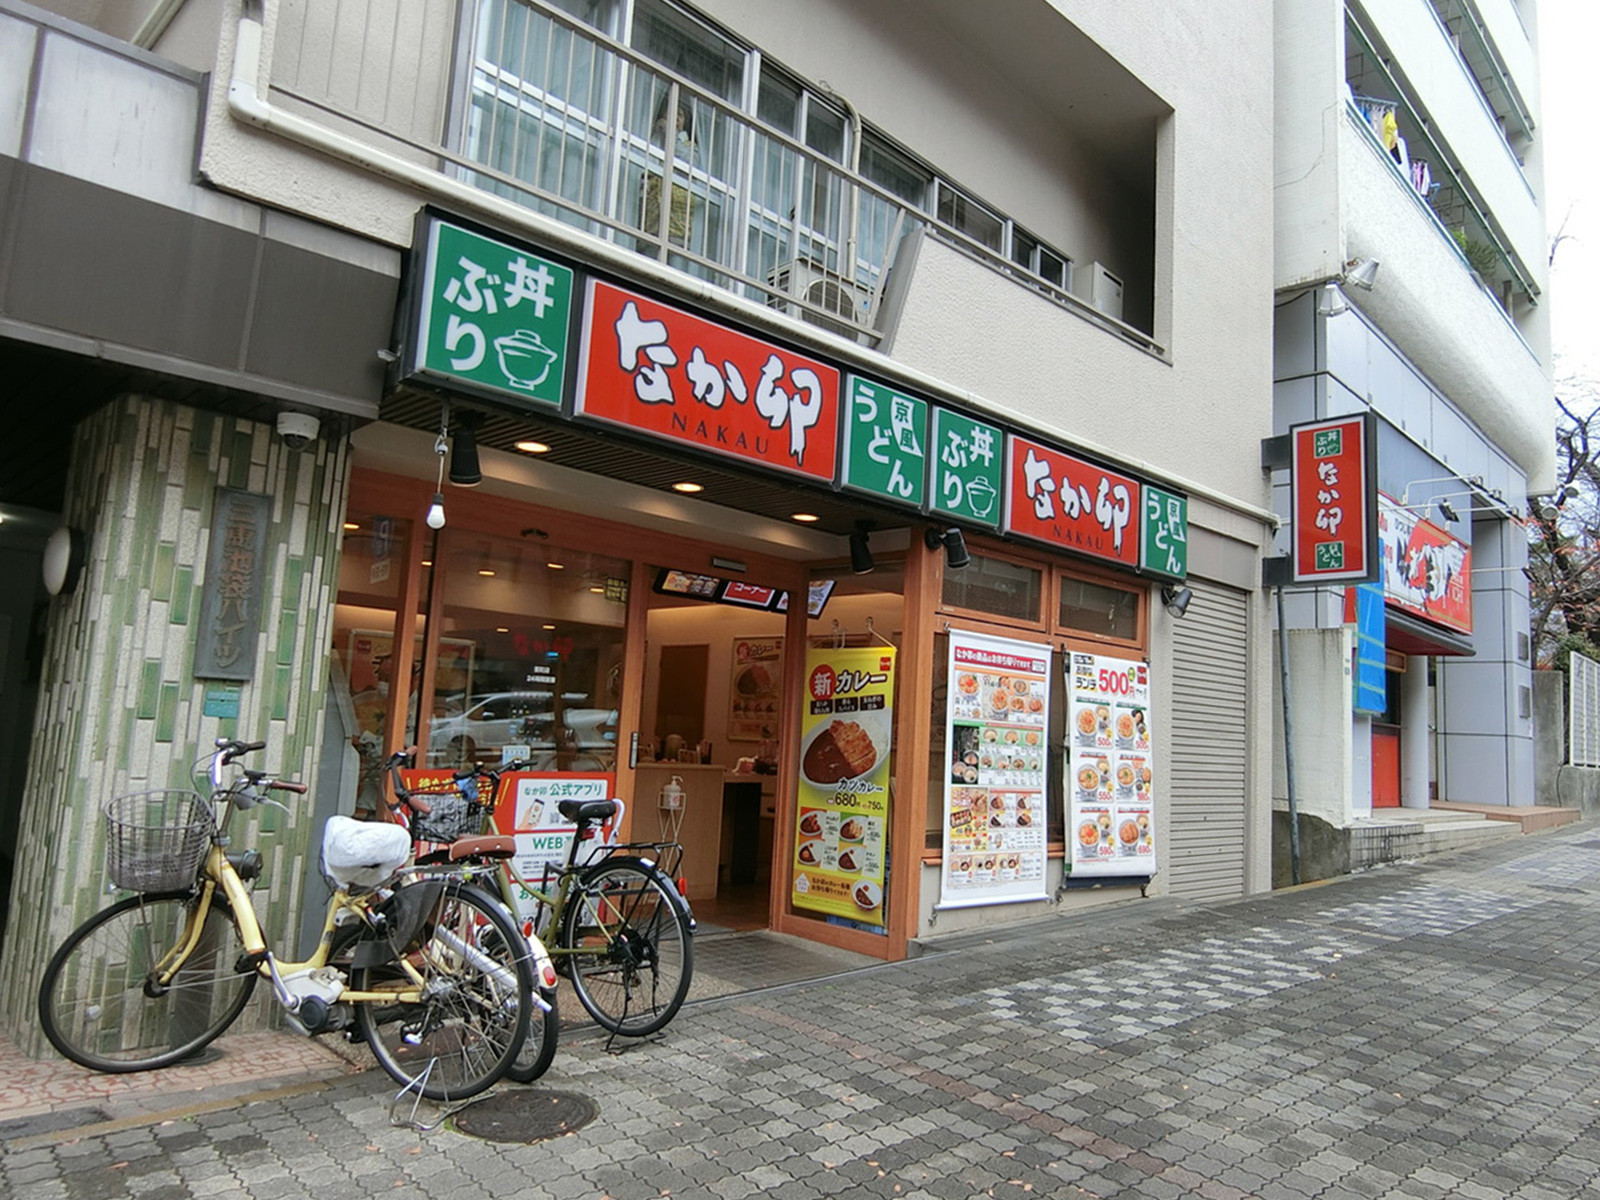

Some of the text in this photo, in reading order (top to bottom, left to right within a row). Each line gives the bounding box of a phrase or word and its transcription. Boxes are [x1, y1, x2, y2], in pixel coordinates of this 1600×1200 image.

[615, 301, 822, 467] なか卯
[672, 412, 769, 454] NAKAU
[855, 384, 914, 498] うどん
[1023, 448, 1130, 556] なか卯
[1315, 462, 1343, 535] なか卯
[1053, 524, 1104, 551] NAKAU
[1147, 493, 1182, 574] うどん
[734, 582, 767, 595] コーナー
[813, 670, 888, 696] 新 カレー
[1075, 676, 1097, 690] ランチ
[524, 781, 603, 797] なか卯 公式アプリ
[838, 778, 884, 793] カツカレー
[867, 800, 884, 811] 750
